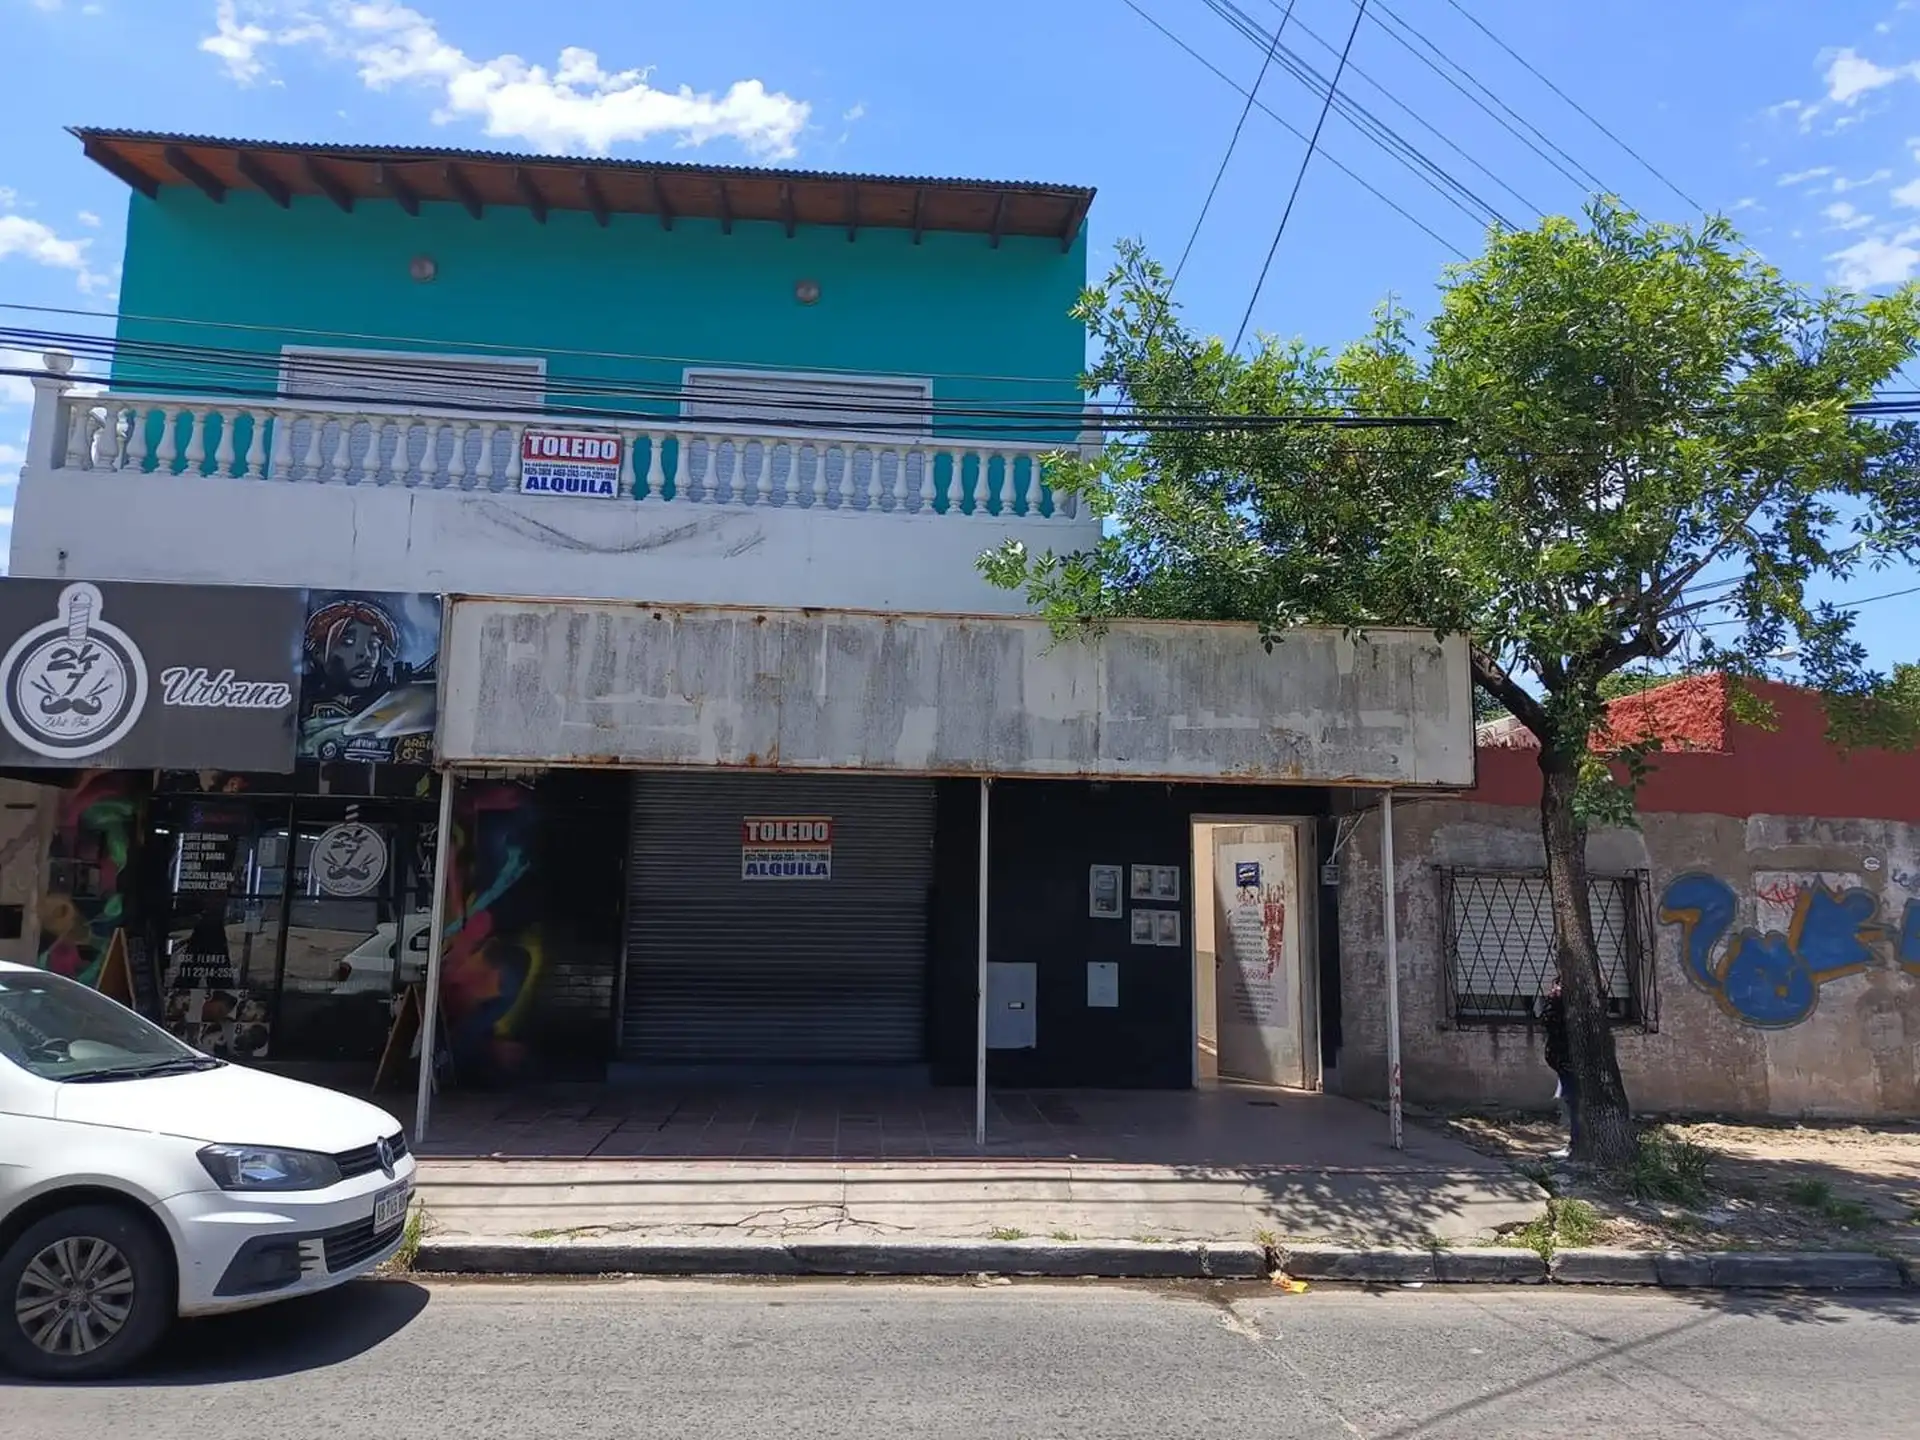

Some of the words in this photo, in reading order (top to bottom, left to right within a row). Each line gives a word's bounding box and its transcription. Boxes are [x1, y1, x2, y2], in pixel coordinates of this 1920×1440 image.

[528, 435, 617, 460] TOLEDO
[526, 477, 613, 494] ALQUILA
[47, 643, 101, 672] 24
[63, 672, 87, 696] 7
[161, 667, 291, 708] Urbana
[746, 821, 829, 841] TOLEDO
[344, 849, 358, 866] 7
[745, 862, 828, 876] ALQUILA
